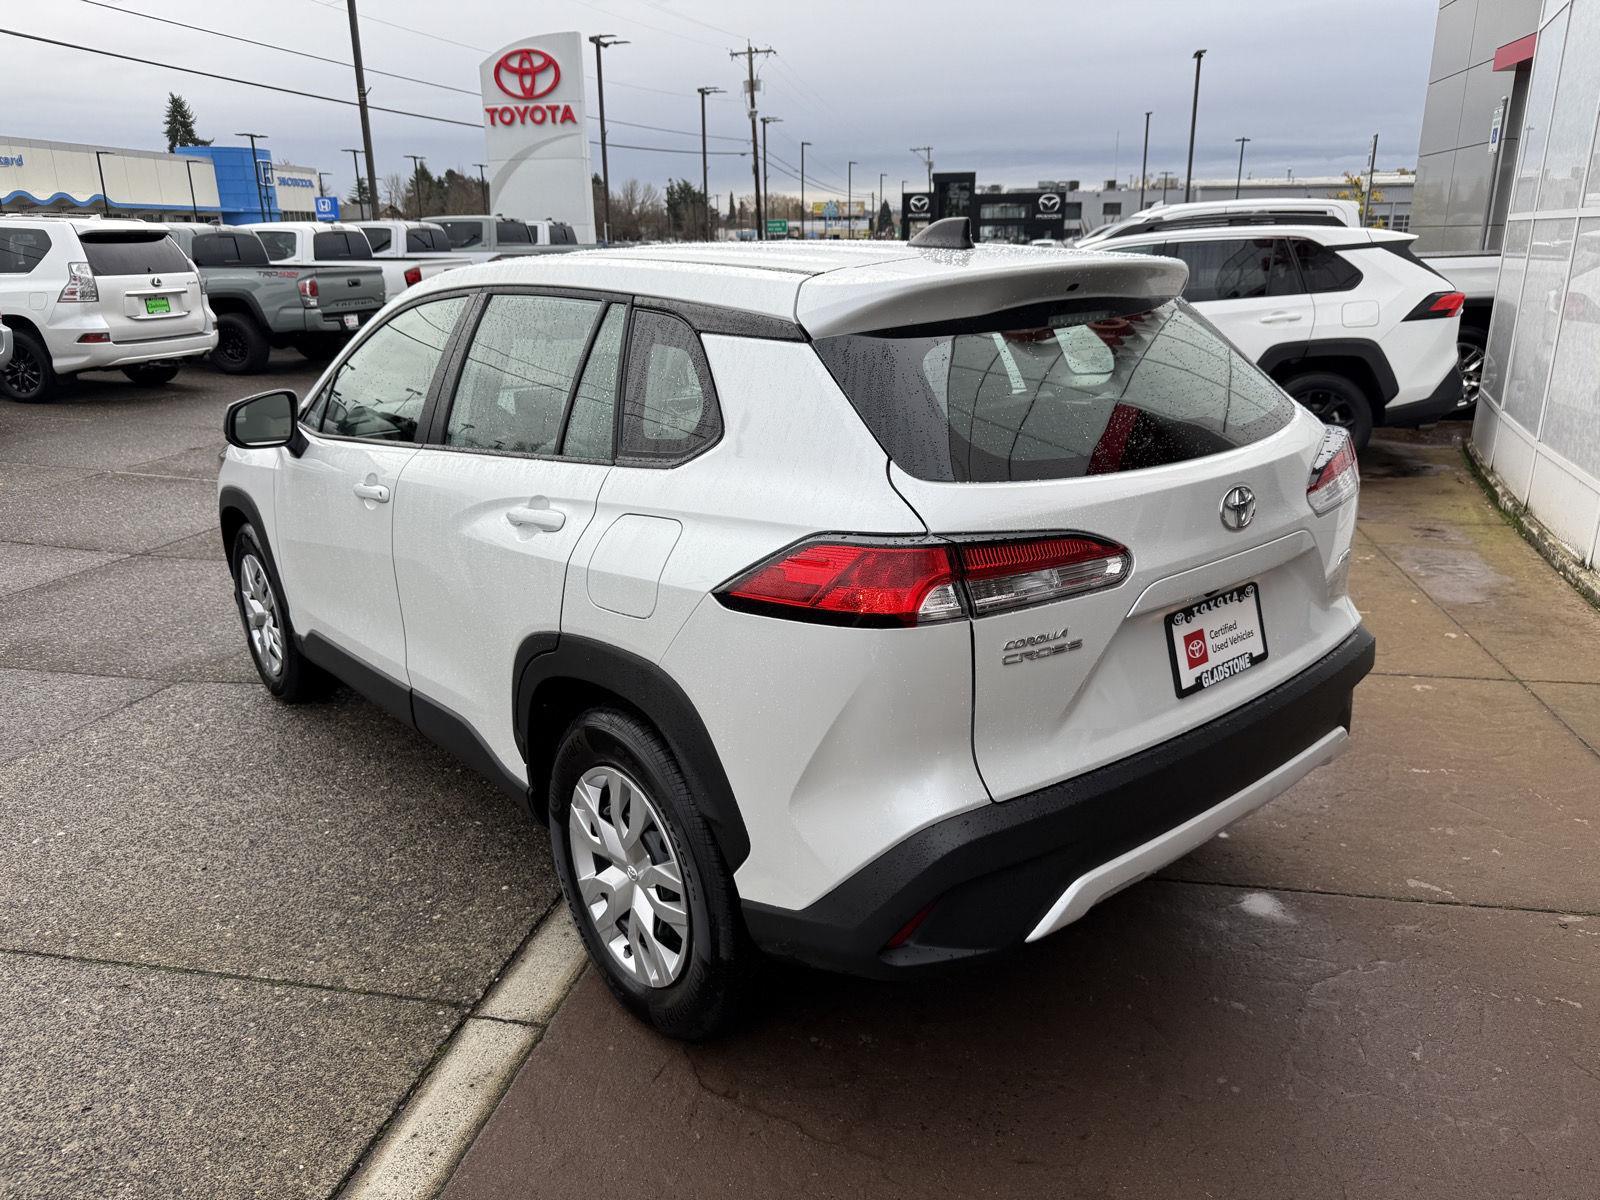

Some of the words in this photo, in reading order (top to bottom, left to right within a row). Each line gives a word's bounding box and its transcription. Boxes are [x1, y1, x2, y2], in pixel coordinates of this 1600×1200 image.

[485, 104, 578, 127] TOYOTA
[277, 176, 315, 188] HONDA
[1192, 591, 1239, 617] TOYOTA
[1003, 628, 1069, 651] COROLLA
[1209, 619, 1238, 639] Certified
[1211, 639, 1229, 653] Used
[1229, 628, 1254, 646] Vehicles
[1002, 639, 1083, 666] CROSS
[1201, 653, 1252, 688] GLADSTONE
